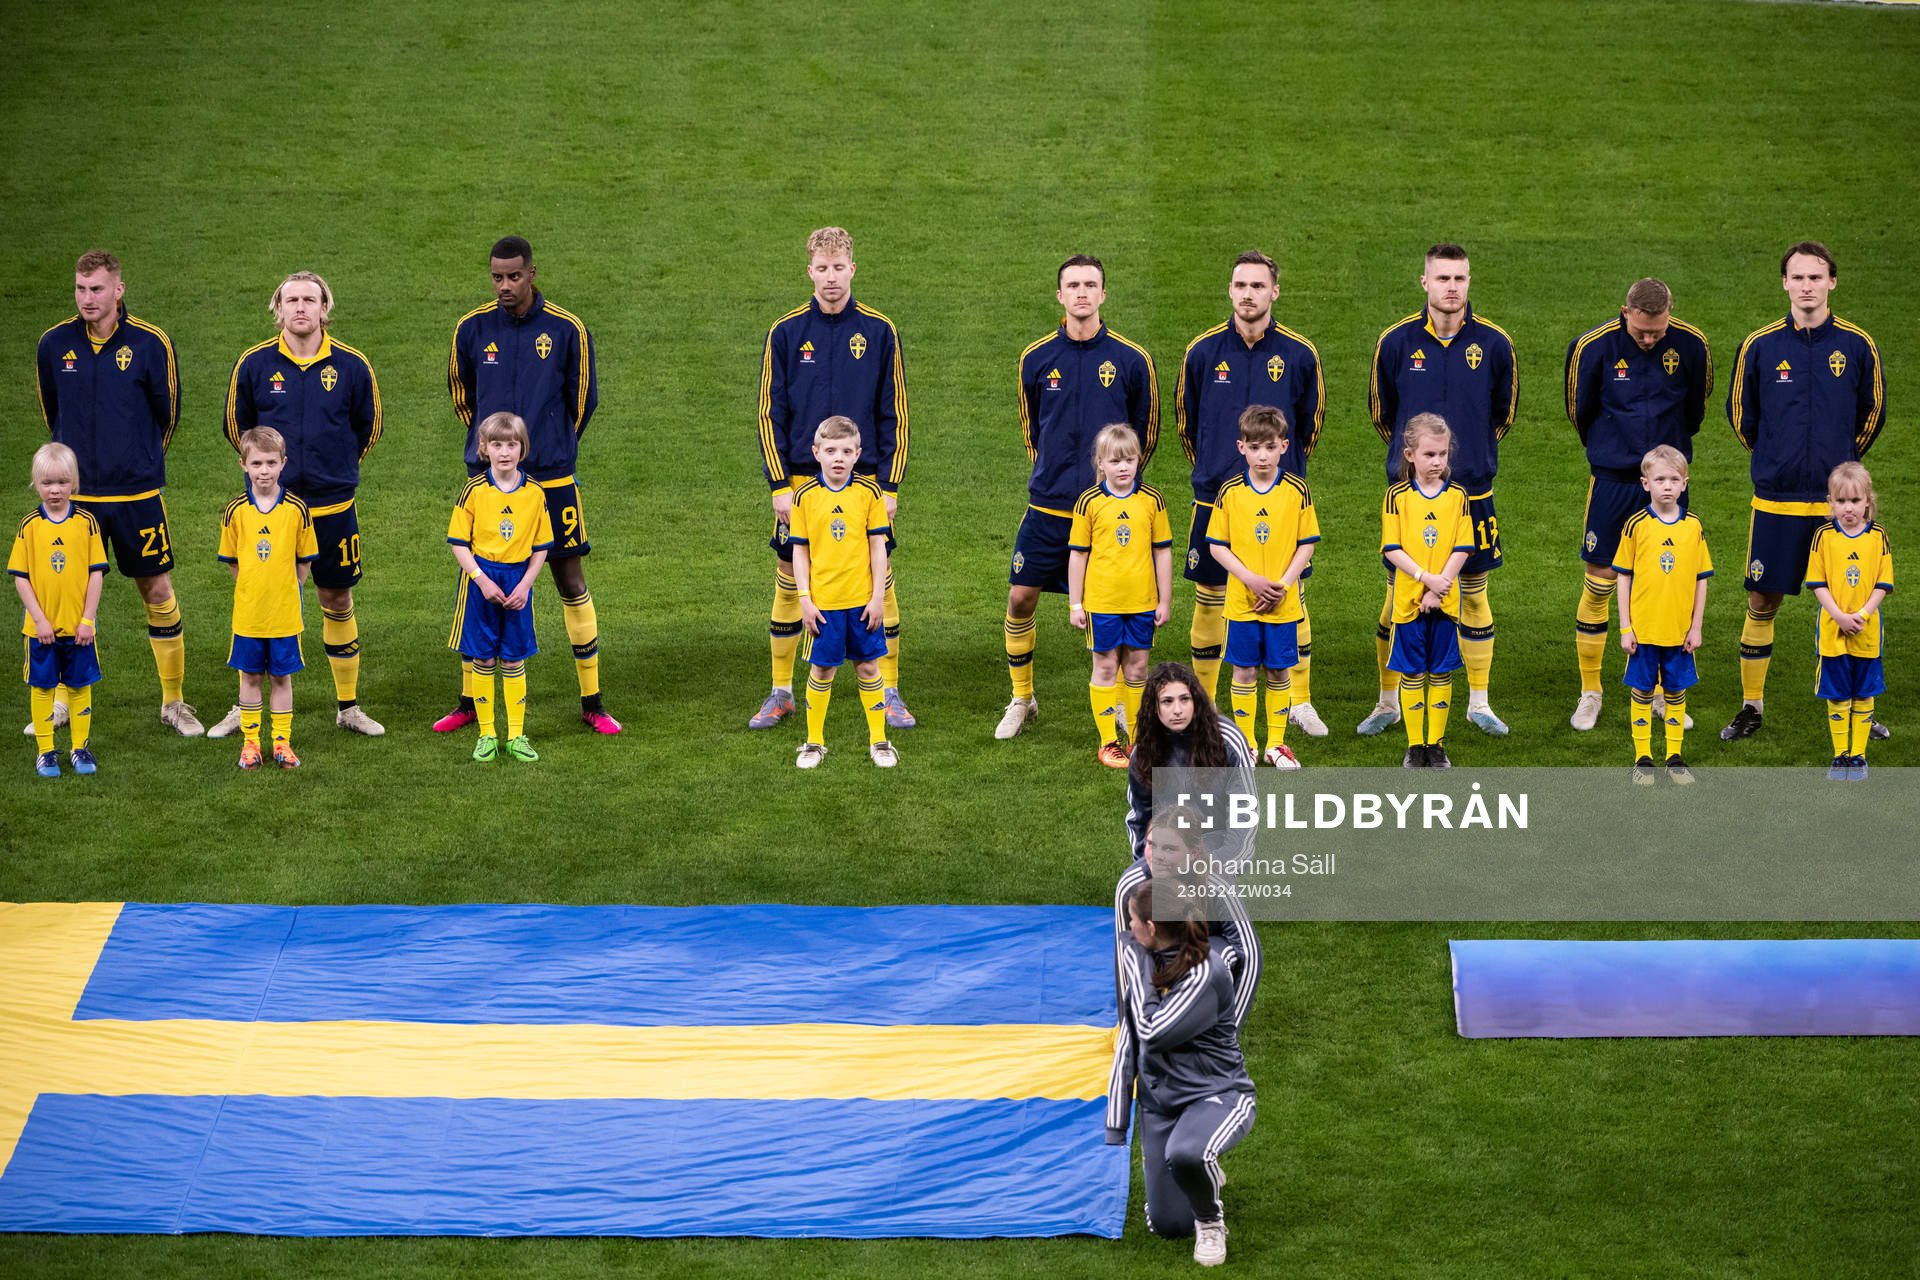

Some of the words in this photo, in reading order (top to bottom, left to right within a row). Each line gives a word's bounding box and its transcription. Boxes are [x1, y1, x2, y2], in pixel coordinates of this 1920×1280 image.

[561, 506, 578, 536] 9
[139, 522, 169, 558] 21
[338, 533, 361, 567] 10
